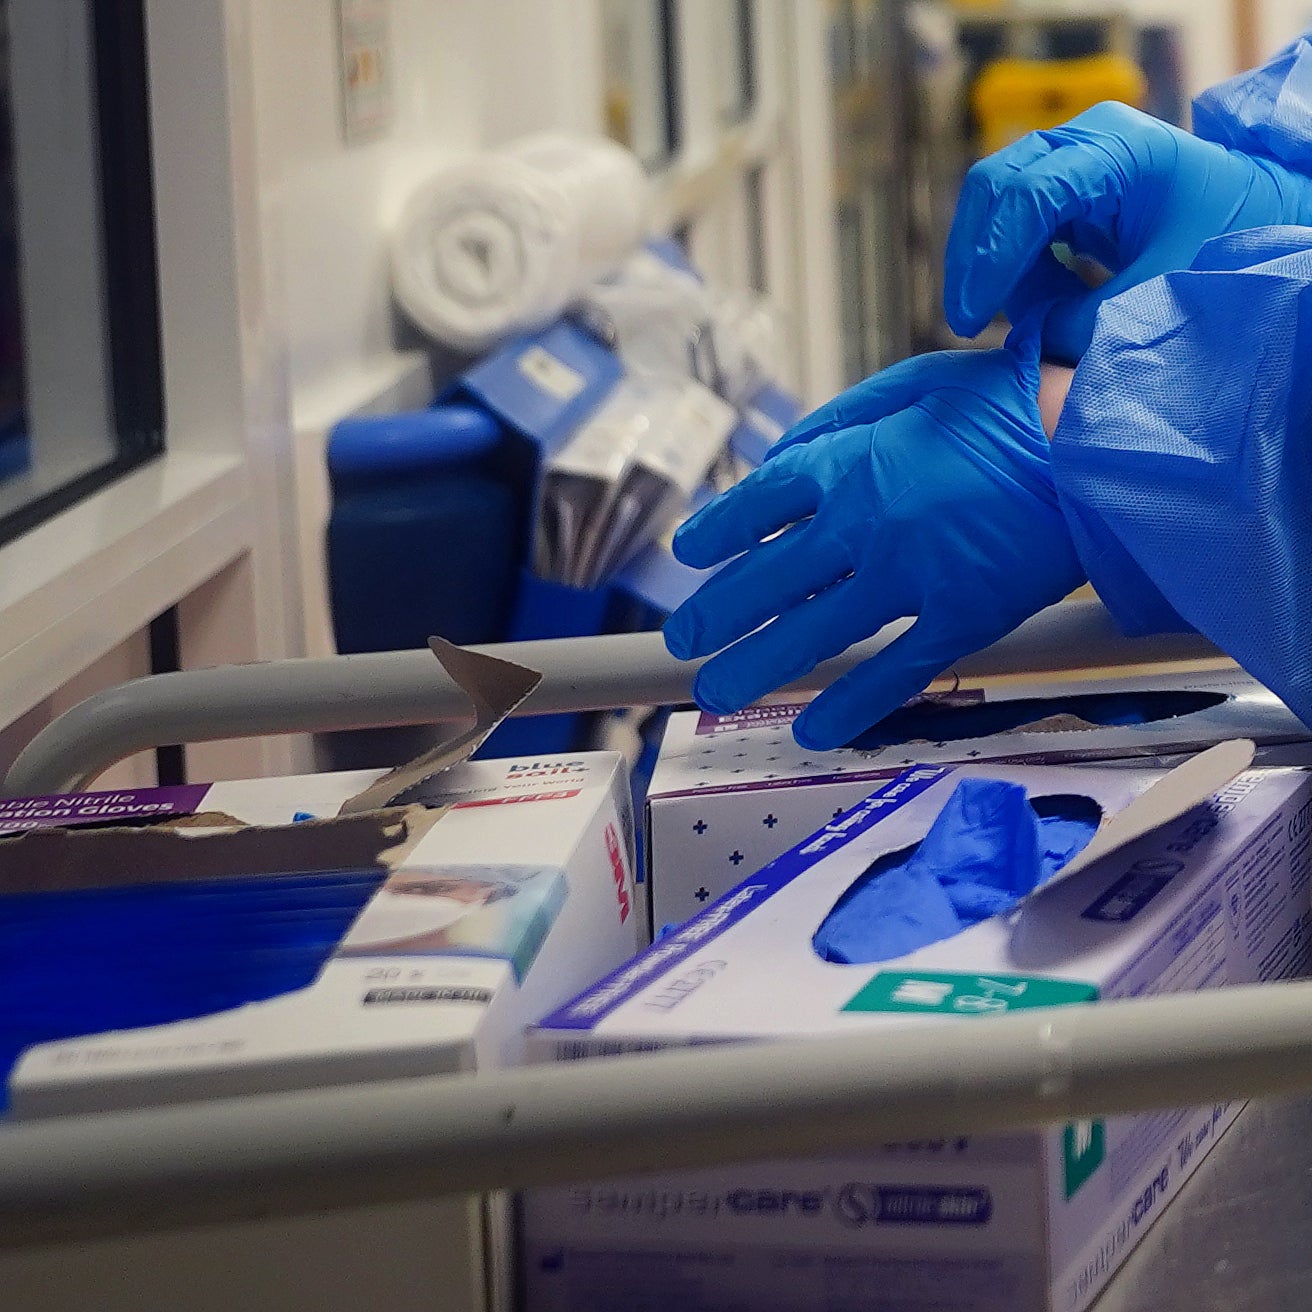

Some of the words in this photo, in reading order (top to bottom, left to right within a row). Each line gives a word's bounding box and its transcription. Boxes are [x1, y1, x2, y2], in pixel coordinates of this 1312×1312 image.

[507, 760, 585, 773] blue
[53, 793, 136, 809] Nitrile
[77, 801, 175, 816] Gloves
[604, 821, 630, 925] 3M
